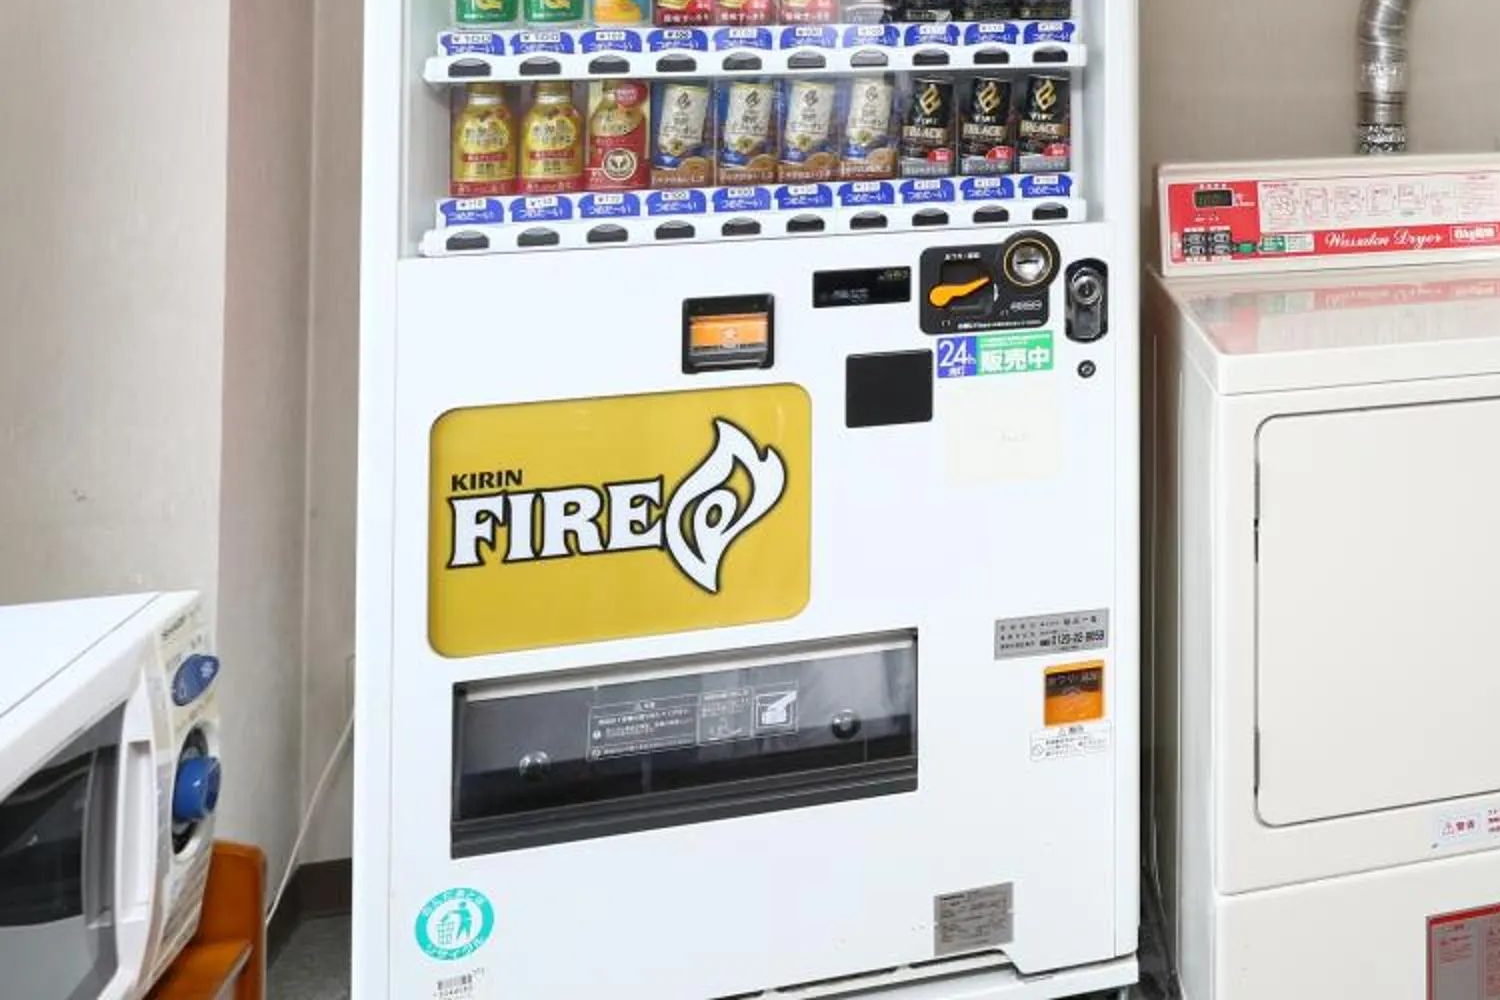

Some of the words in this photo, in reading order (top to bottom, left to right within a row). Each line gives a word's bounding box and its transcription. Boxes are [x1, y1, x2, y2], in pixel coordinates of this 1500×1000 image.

[1394, 229, 1443, 250] Dryer
[981, 345, 1051, 372] 販売中
[451, 469, 523, 492] KIRIN
[445, 474, 667, 570] FIRE
